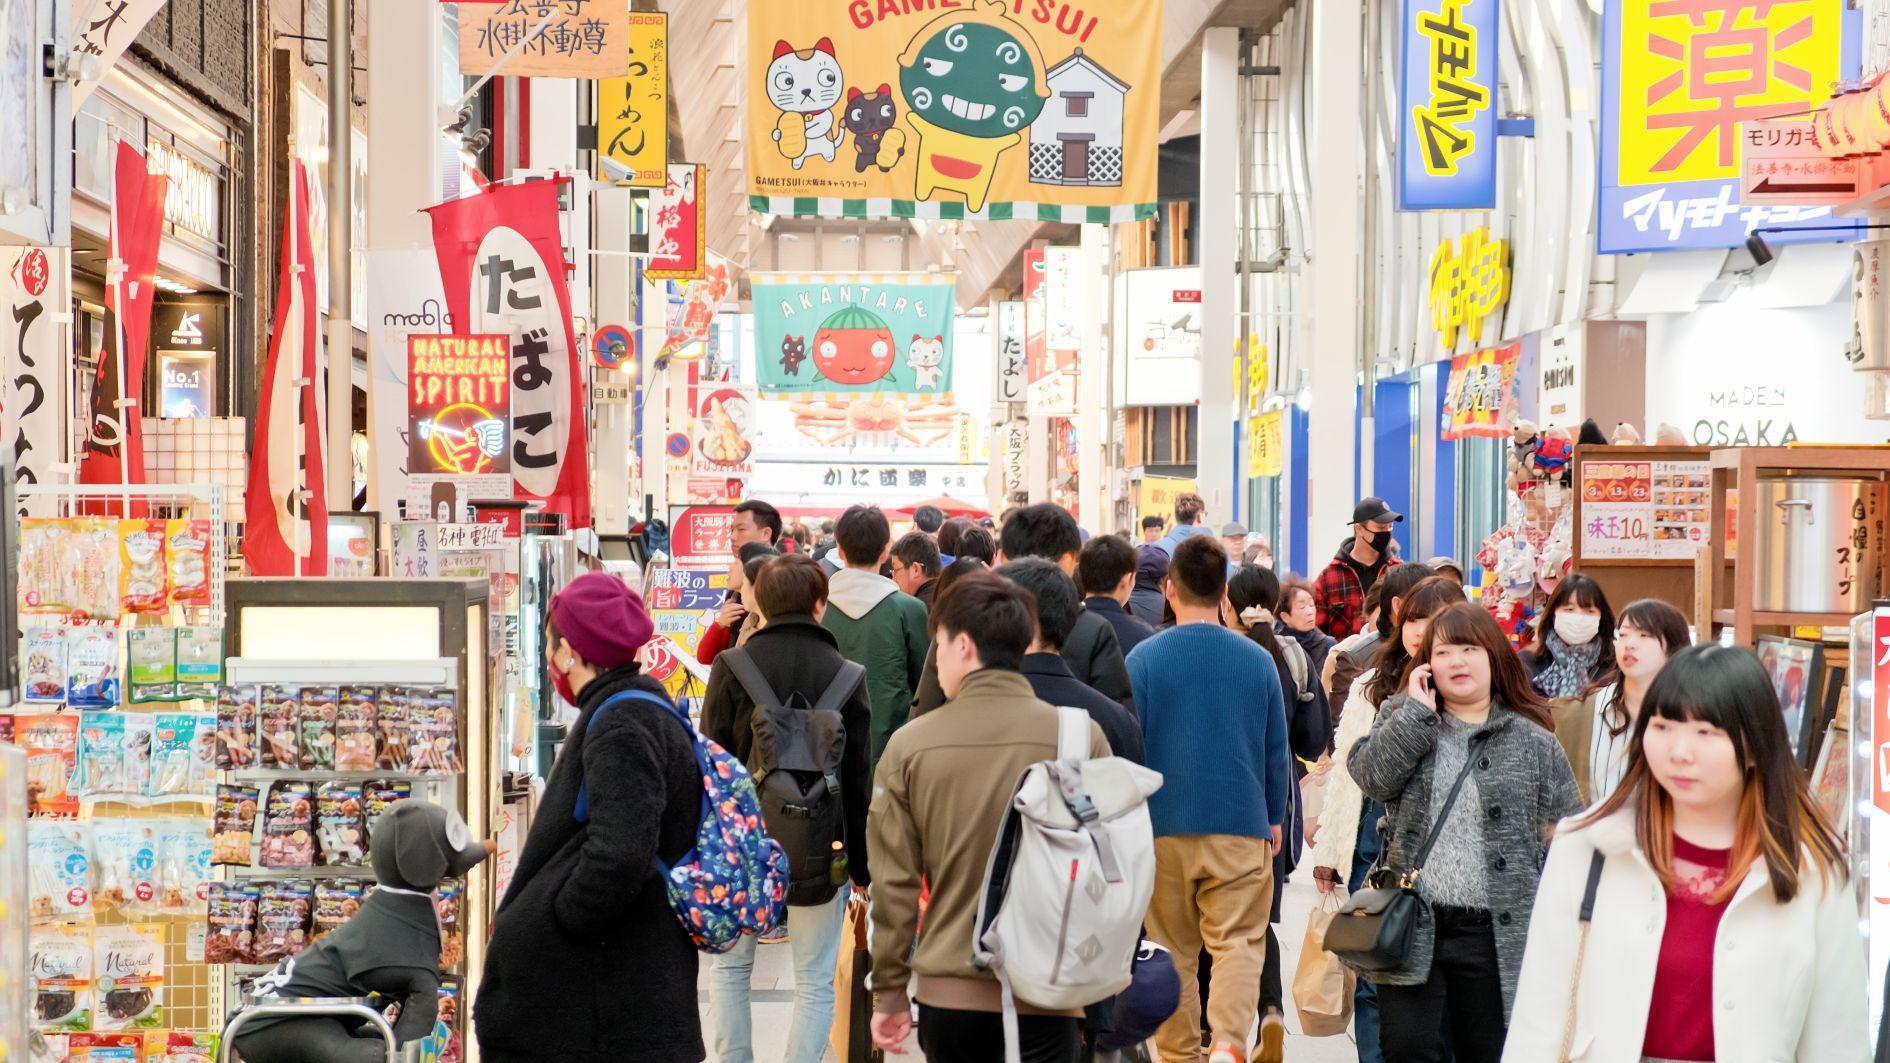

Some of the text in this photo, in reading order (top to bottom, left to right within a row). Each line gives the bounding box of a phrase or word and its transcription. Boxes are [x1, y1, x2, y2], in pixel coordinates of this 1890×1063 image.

[477, 18, 609, 57] 水掛不動尊
[847, 0, 1098, 43] GAMSUI
[1647, 0, 1813, 173] 薬
[779, 286, 928, 319] AKANTARE
[412, 338, 506, 358] NATURAL
[479, 254, 558, 469] たばこ
[413, 358, 506, 376] AMERICAN
[1003, 335, 1021, 399] たよし
[414, 376, 508, 405] SPIRIT
[1693, 418, 1800, 447] OSAKA
[654, 571, 706, 588] 難波の
[1835, 546, 1857, 596] スープ
[104, 950, 154, 975] Natural
